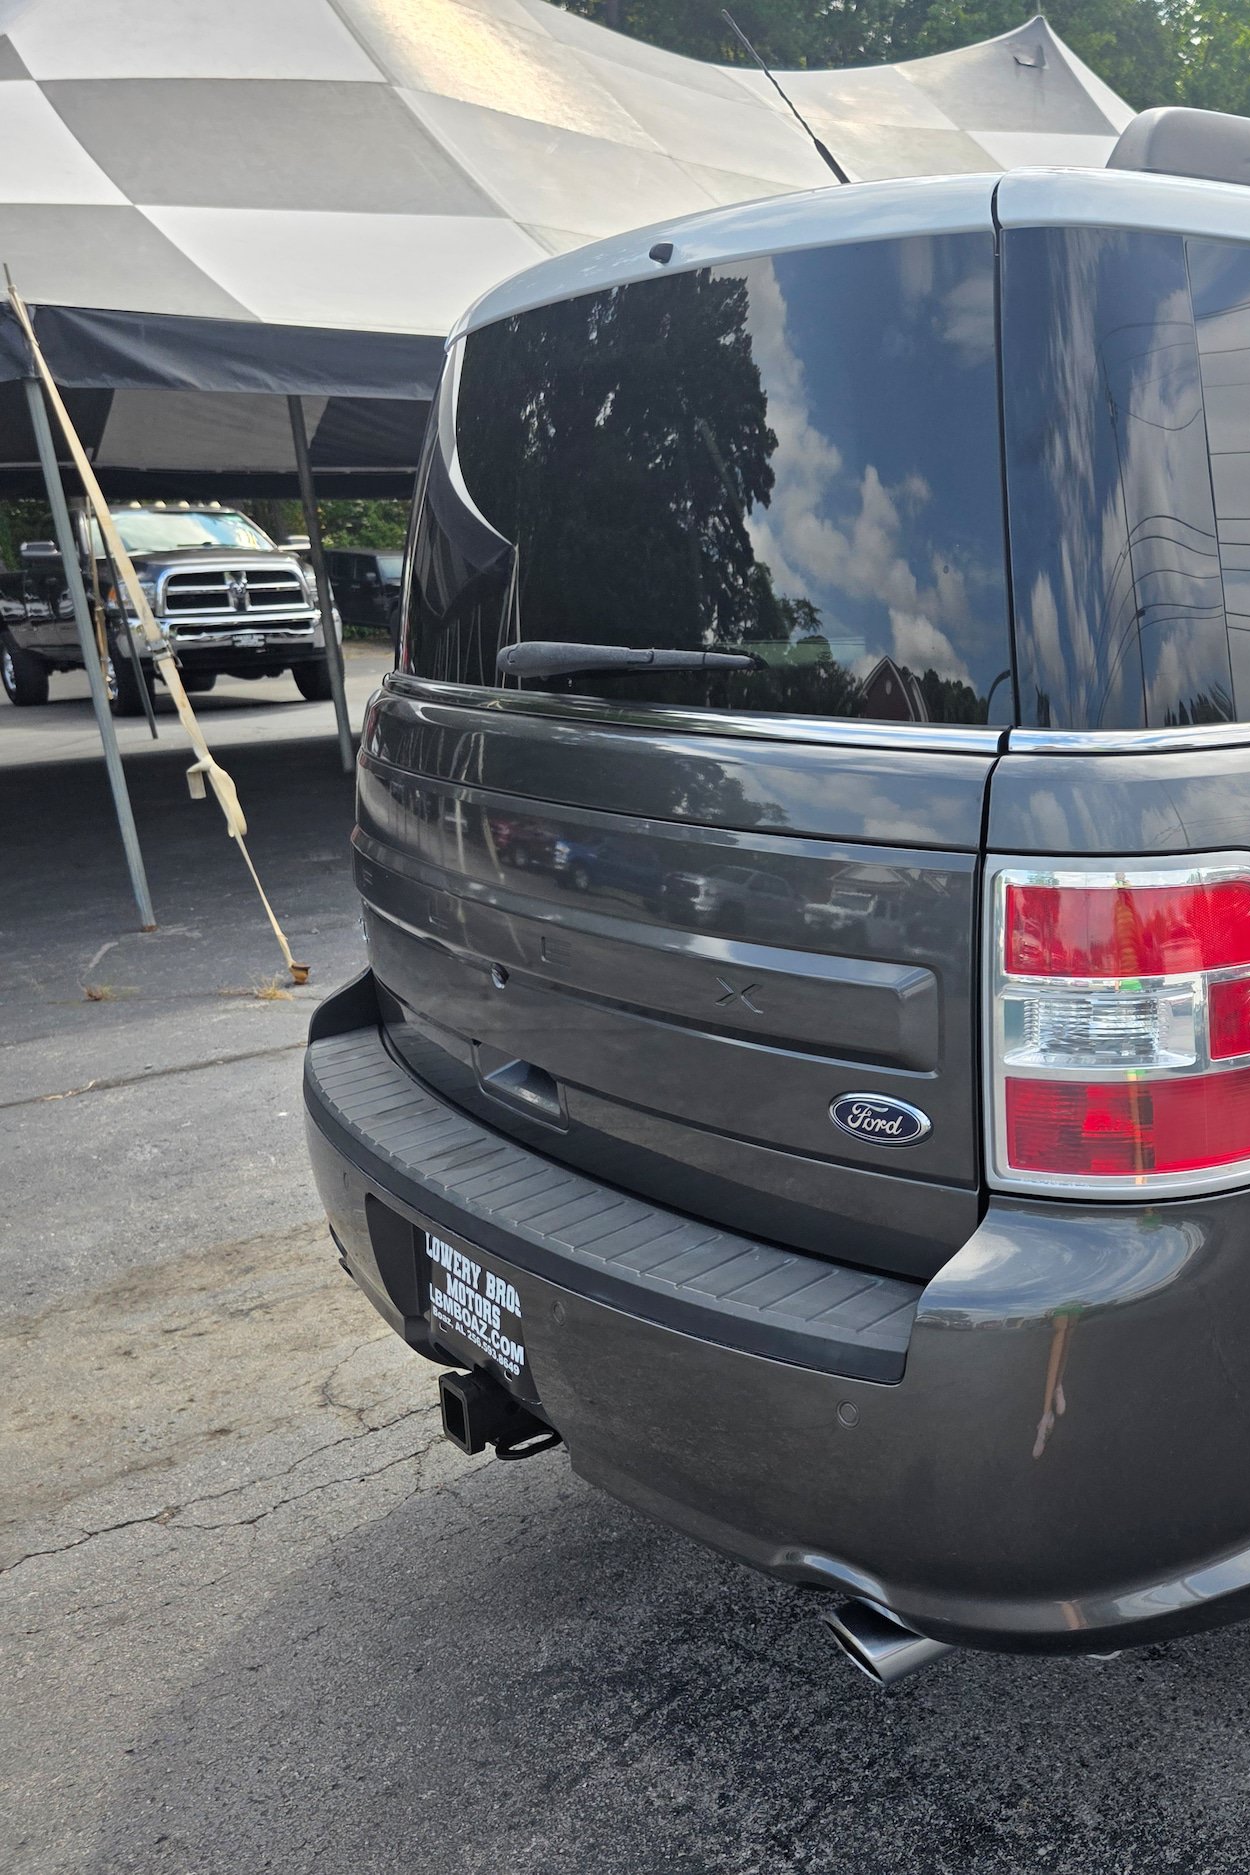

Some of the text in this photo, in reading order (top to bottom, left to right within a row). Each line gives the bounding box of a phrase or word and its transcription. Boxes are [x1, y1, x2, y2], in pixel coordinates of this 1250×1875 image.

[847, 1102, 902, 1135] Ford
[425, 1232, 481, 1290] LOWERY
[429, 1283, 525, 1366] LBMBOAZ.COM
[432, 1305, 454, 1329] Boaz,
[455, 1321, 466, 1336] AL
[446, 1272, 501, 1331] MOTORS
